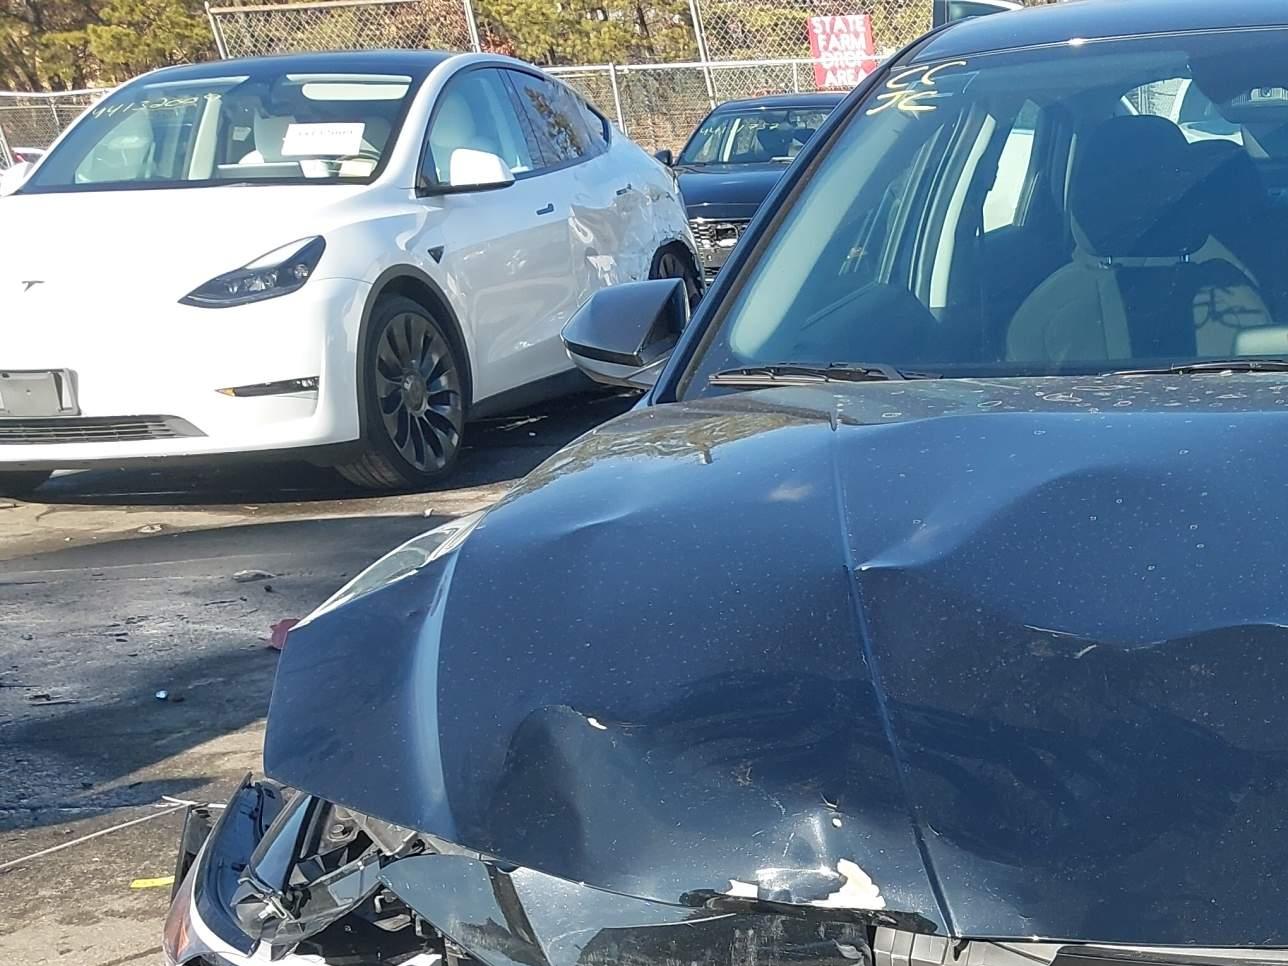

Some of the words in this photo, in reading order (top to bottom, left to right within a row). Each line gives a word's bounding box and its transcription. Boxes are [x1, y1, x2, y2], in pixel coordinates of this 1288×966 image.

[811, 16, 866, 33] STATE
[817, 34, 866, 49] FARM
[824, 68, 868, 87] AREA
